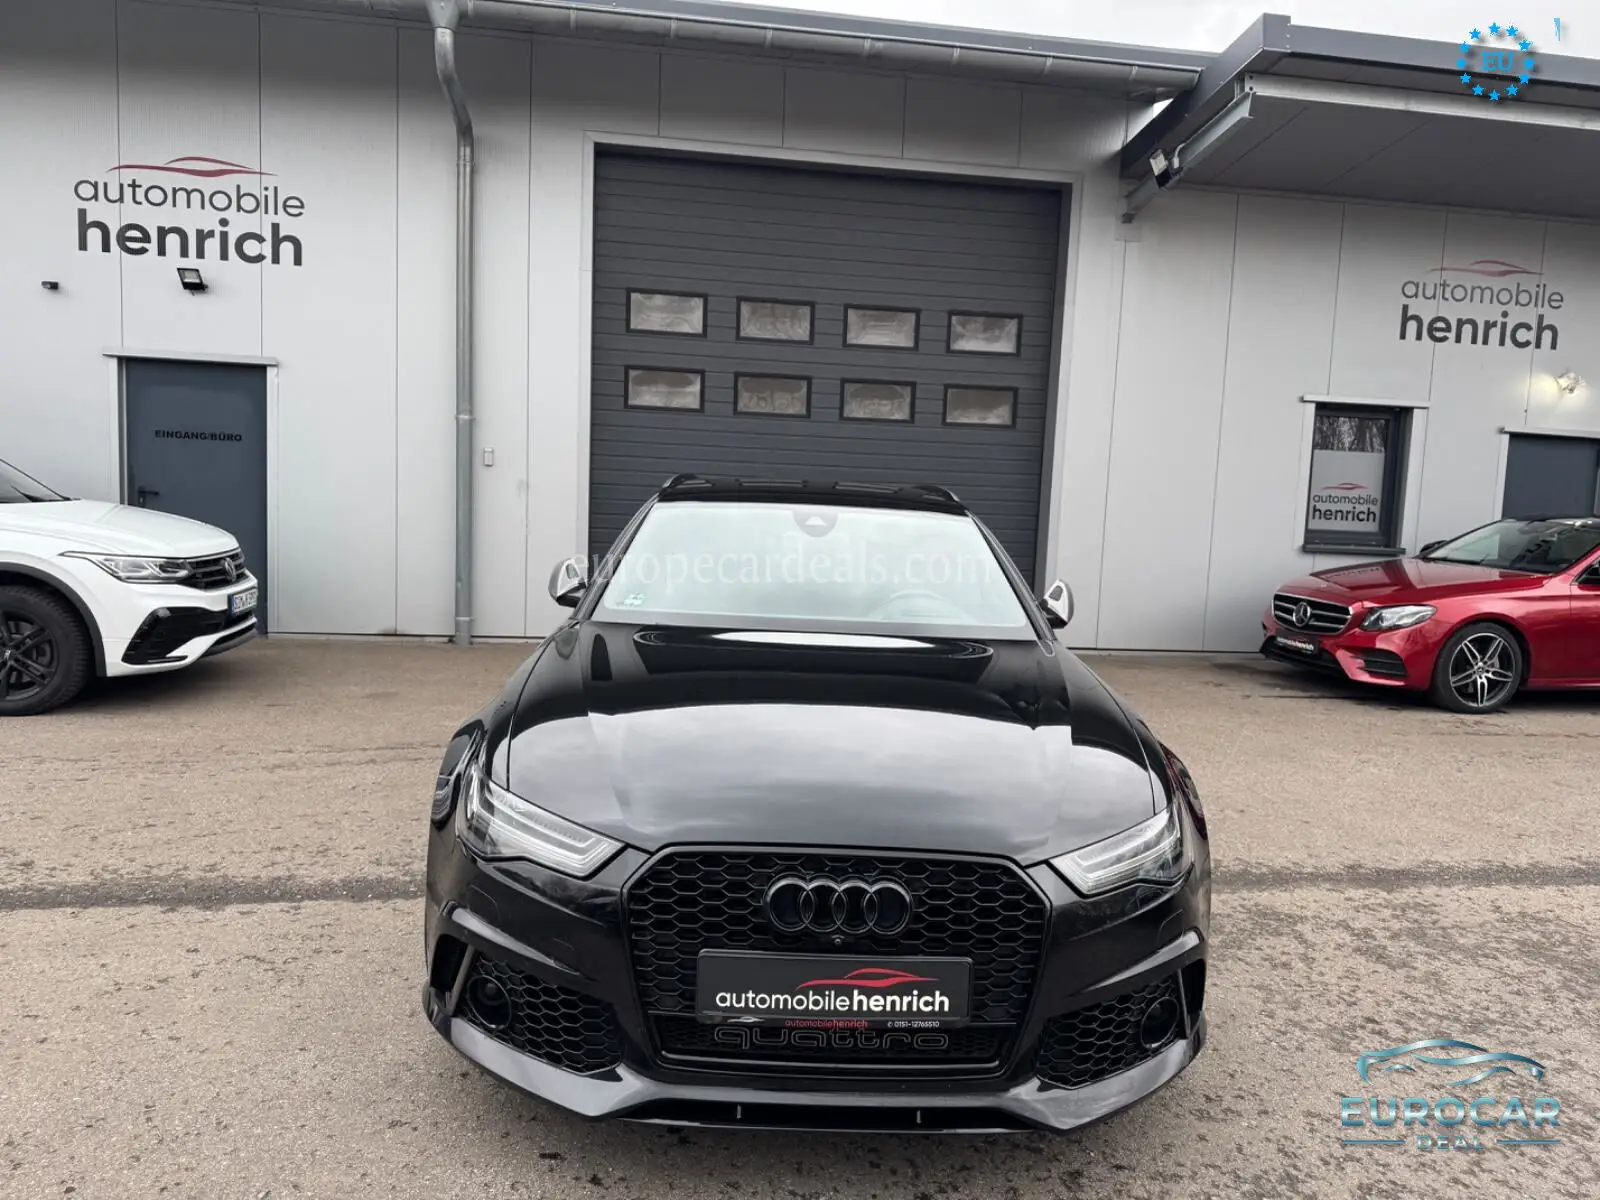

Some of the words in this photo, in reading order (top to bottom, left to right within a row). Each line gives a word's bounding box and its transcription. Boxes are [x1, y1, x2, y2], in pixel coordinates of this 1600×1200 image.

[74, 177, 305, 218] automobile
[77, 207, 303, 266] henrich
[1401, 279, 1564, 309] automobile
[1399, 303, 1559, 350] henrich
[154, 429, 242, 442] EINGANG/BÜRO
[1312, 493, 1379, 507] automobile
[1312, 504, 1377, 523] henrich
[715, 989, 950, 1013] automobilehenrich
[714, 1026, 949, 1050] quattro
